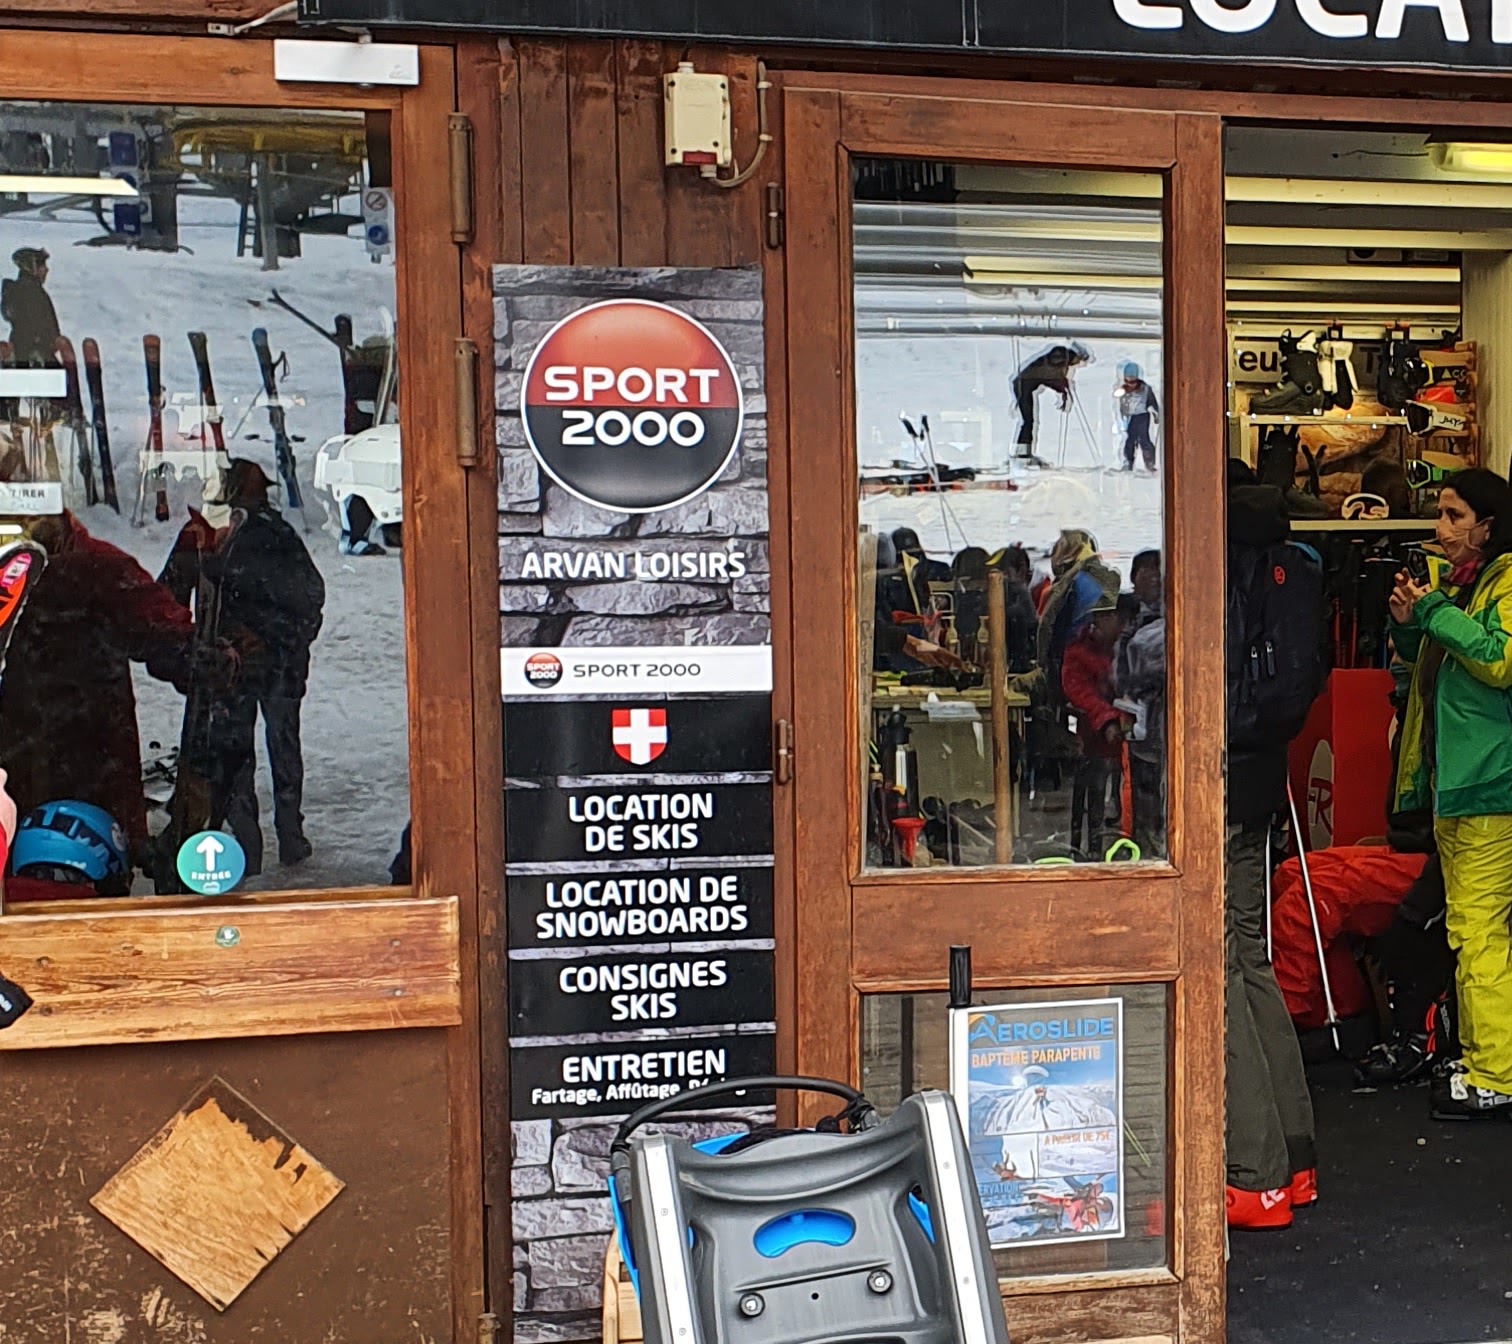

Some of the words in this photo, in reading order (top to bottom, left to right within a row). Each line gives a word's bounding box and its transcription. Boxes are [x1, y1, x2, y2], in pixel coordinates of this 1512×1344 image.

[544, 366, 720, 403] SPORT
[562, 410, 705, 447] 2000
[521, 552, 626, 578] ARVAN
[635, 552, 746, 578] LOISIRS
[527, 663, 560, 671] SPORT
[530, 671, 557, 679] 2000
[573, 664, 641, 677] SPORT
[646, 663, 702, 676] 2000
[568, 792, 714, 823] LOCATION
[585, 825, 624, 852] DE
[633, 823, 698, 851] SKIS
[545, 878, 691, 909] LOCATION
[700, 875, 737, 902] DE
[536, 905, 748, 939] SNOWBOARDS
[559, 960, 727, 993] CONSIGNES
[611, 992, 677, 1021] SKIS
[969, 1017, 1114, 1045] AEROSLIDE
[562, 1048, 726, 1083] ENTRETIEN
[532, 1087, 602, 1105] Fartage,
